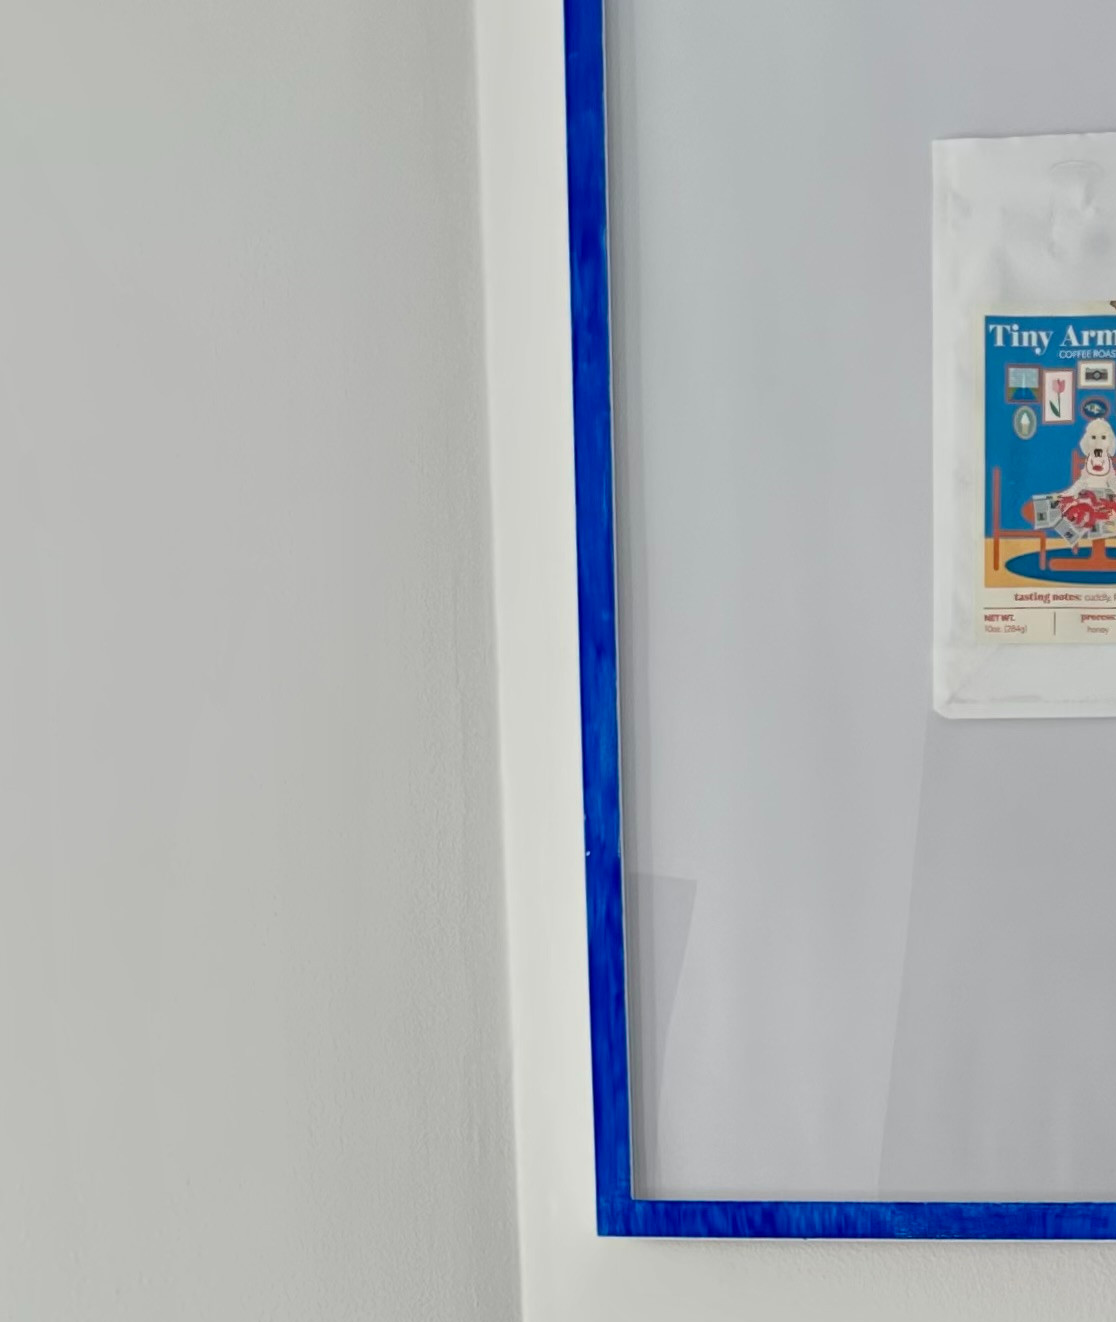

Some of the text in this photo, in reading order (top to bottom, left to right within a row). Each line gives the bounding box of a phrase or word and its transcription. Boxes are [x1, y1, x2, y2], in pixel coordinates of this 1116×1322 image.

[989, 324, 1053, 356] Tiny
[1059, 350, 1091, 359] COFFEE
[1014, 592, 1051, 604] tasting
[1052, 592, 1082, 601] notes:
[984, 614, 999, 622] NET
[1087, 625, 1109, 635] honey
